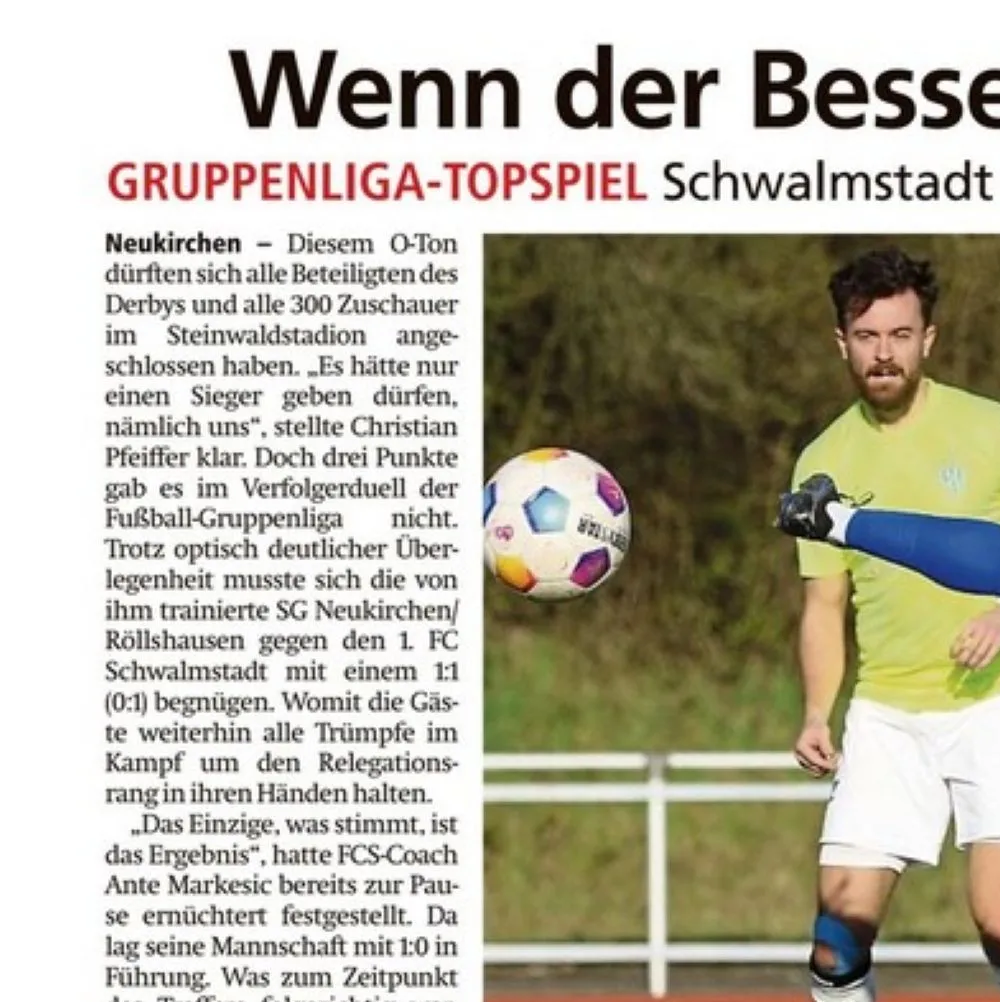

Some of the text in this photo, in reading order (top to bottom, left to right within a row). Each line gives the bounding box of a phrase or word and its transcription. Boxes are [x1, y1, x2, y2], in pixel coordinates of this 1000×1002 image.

[227, 49, 520, 131] Wenn
[554, 43, 720, 130] der
[107, 161, 648, 202] GRUPPENLIGA-TOPSPIEL
[663, 158, 994, 202] Schwalmstadt
[105, 230, 242, 255] Neukirchen
[288, 232, 374, 255] Diesem
[390, 232, 458, 255] O-Ton
[105, 293, 460, 321] Derbys und alle 300 Zuschauer
[105, 445, 459, 469] Pfeiffer klar. Doch drei Punkte
[105, 659, 459, 682] Schwalmstadt mit einem 1:1
